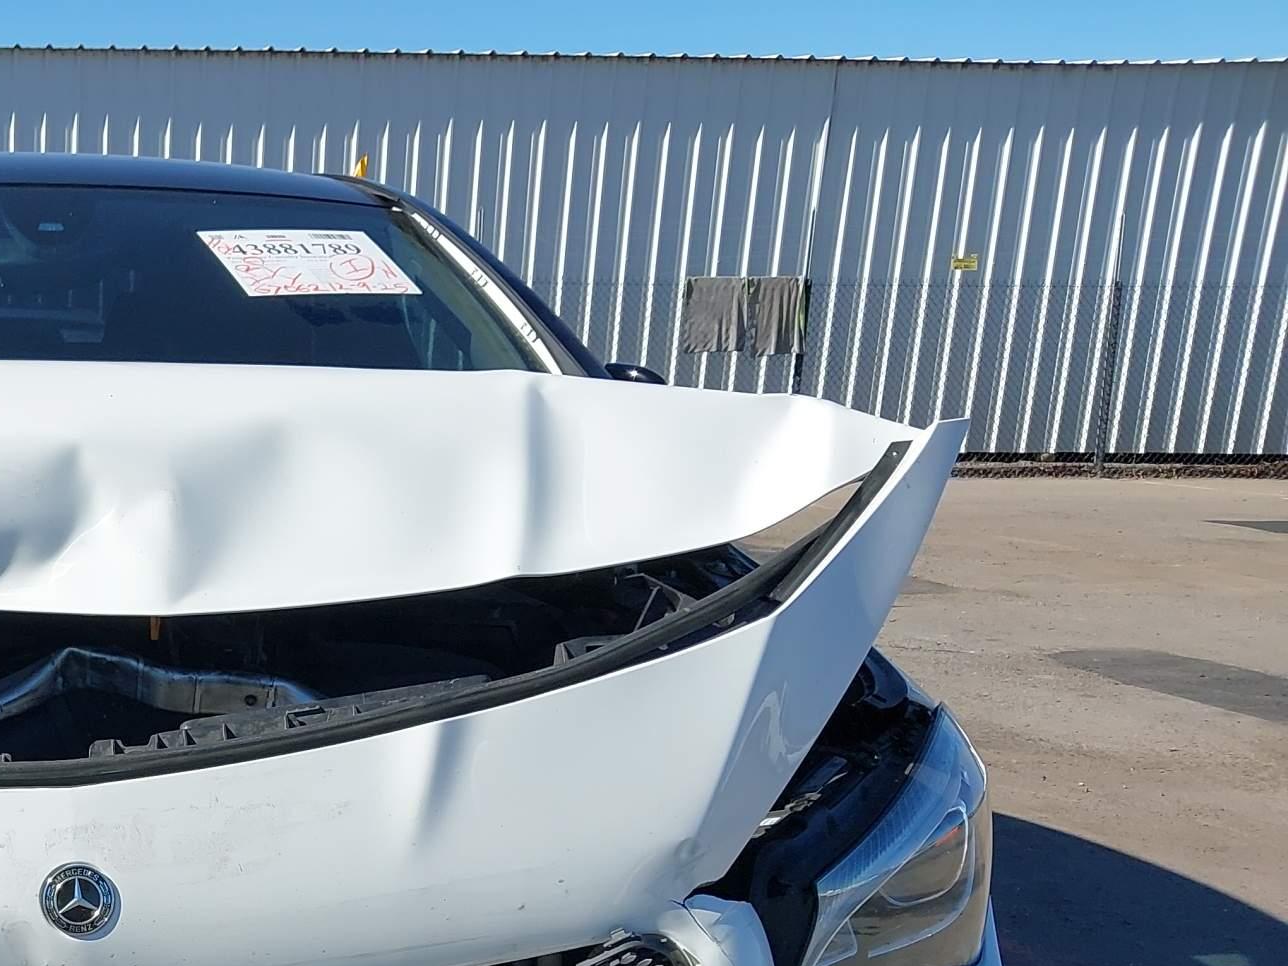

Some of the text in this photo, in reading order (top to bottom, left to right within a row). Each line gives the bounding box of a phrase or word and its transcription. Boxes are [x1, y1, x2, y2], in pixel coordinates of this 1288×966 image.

[232, 243, 362, 256] 43881789
[55, 868, 99, 884] MERCEDES
[69, 924, 93, 932] BENZ
